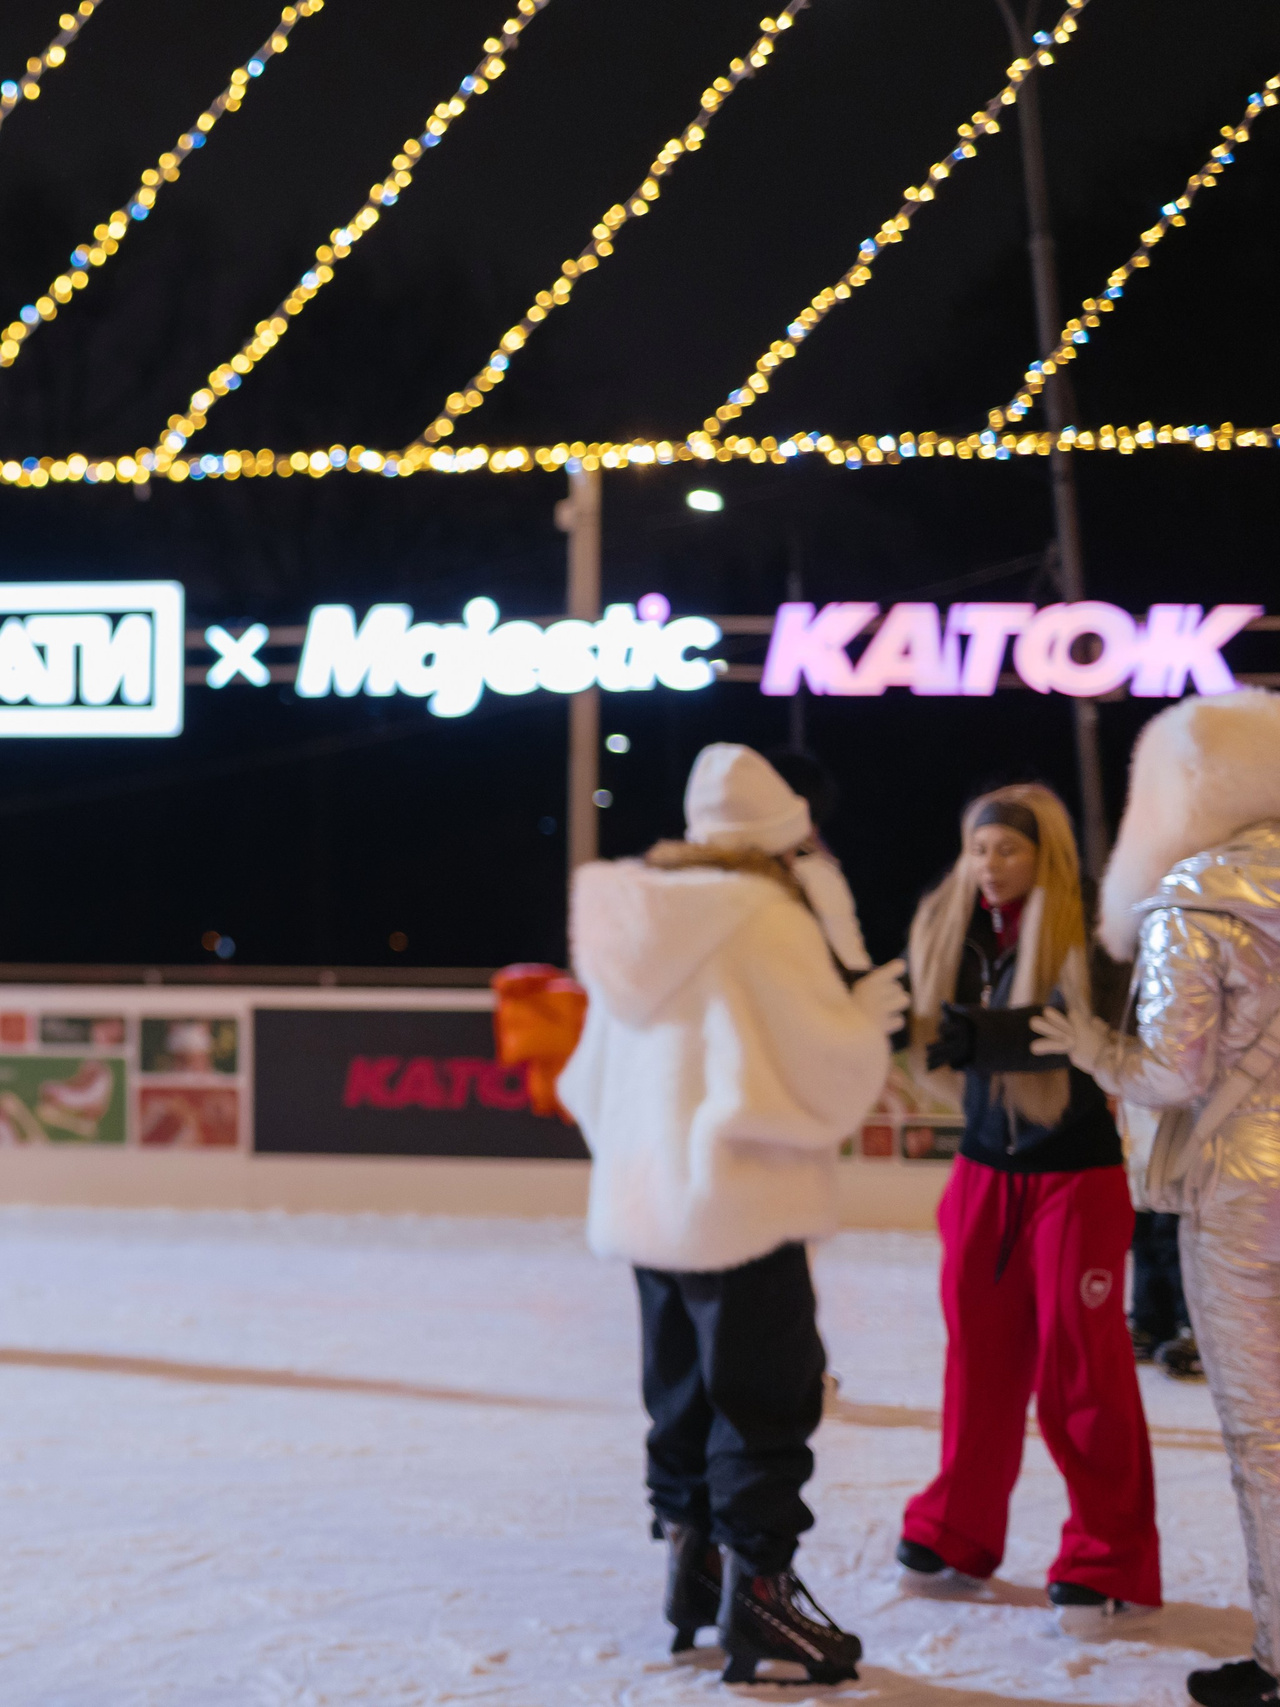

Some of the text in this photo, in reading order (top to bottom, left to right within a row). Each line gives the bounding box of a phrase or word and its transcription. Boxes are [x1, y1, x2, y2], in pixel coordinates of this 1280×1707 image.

[295, 592, 721, 718] Majestic
[760, 600, 1265, 698] КАТОК
[343, 1055, 532, 1110] КАТО
